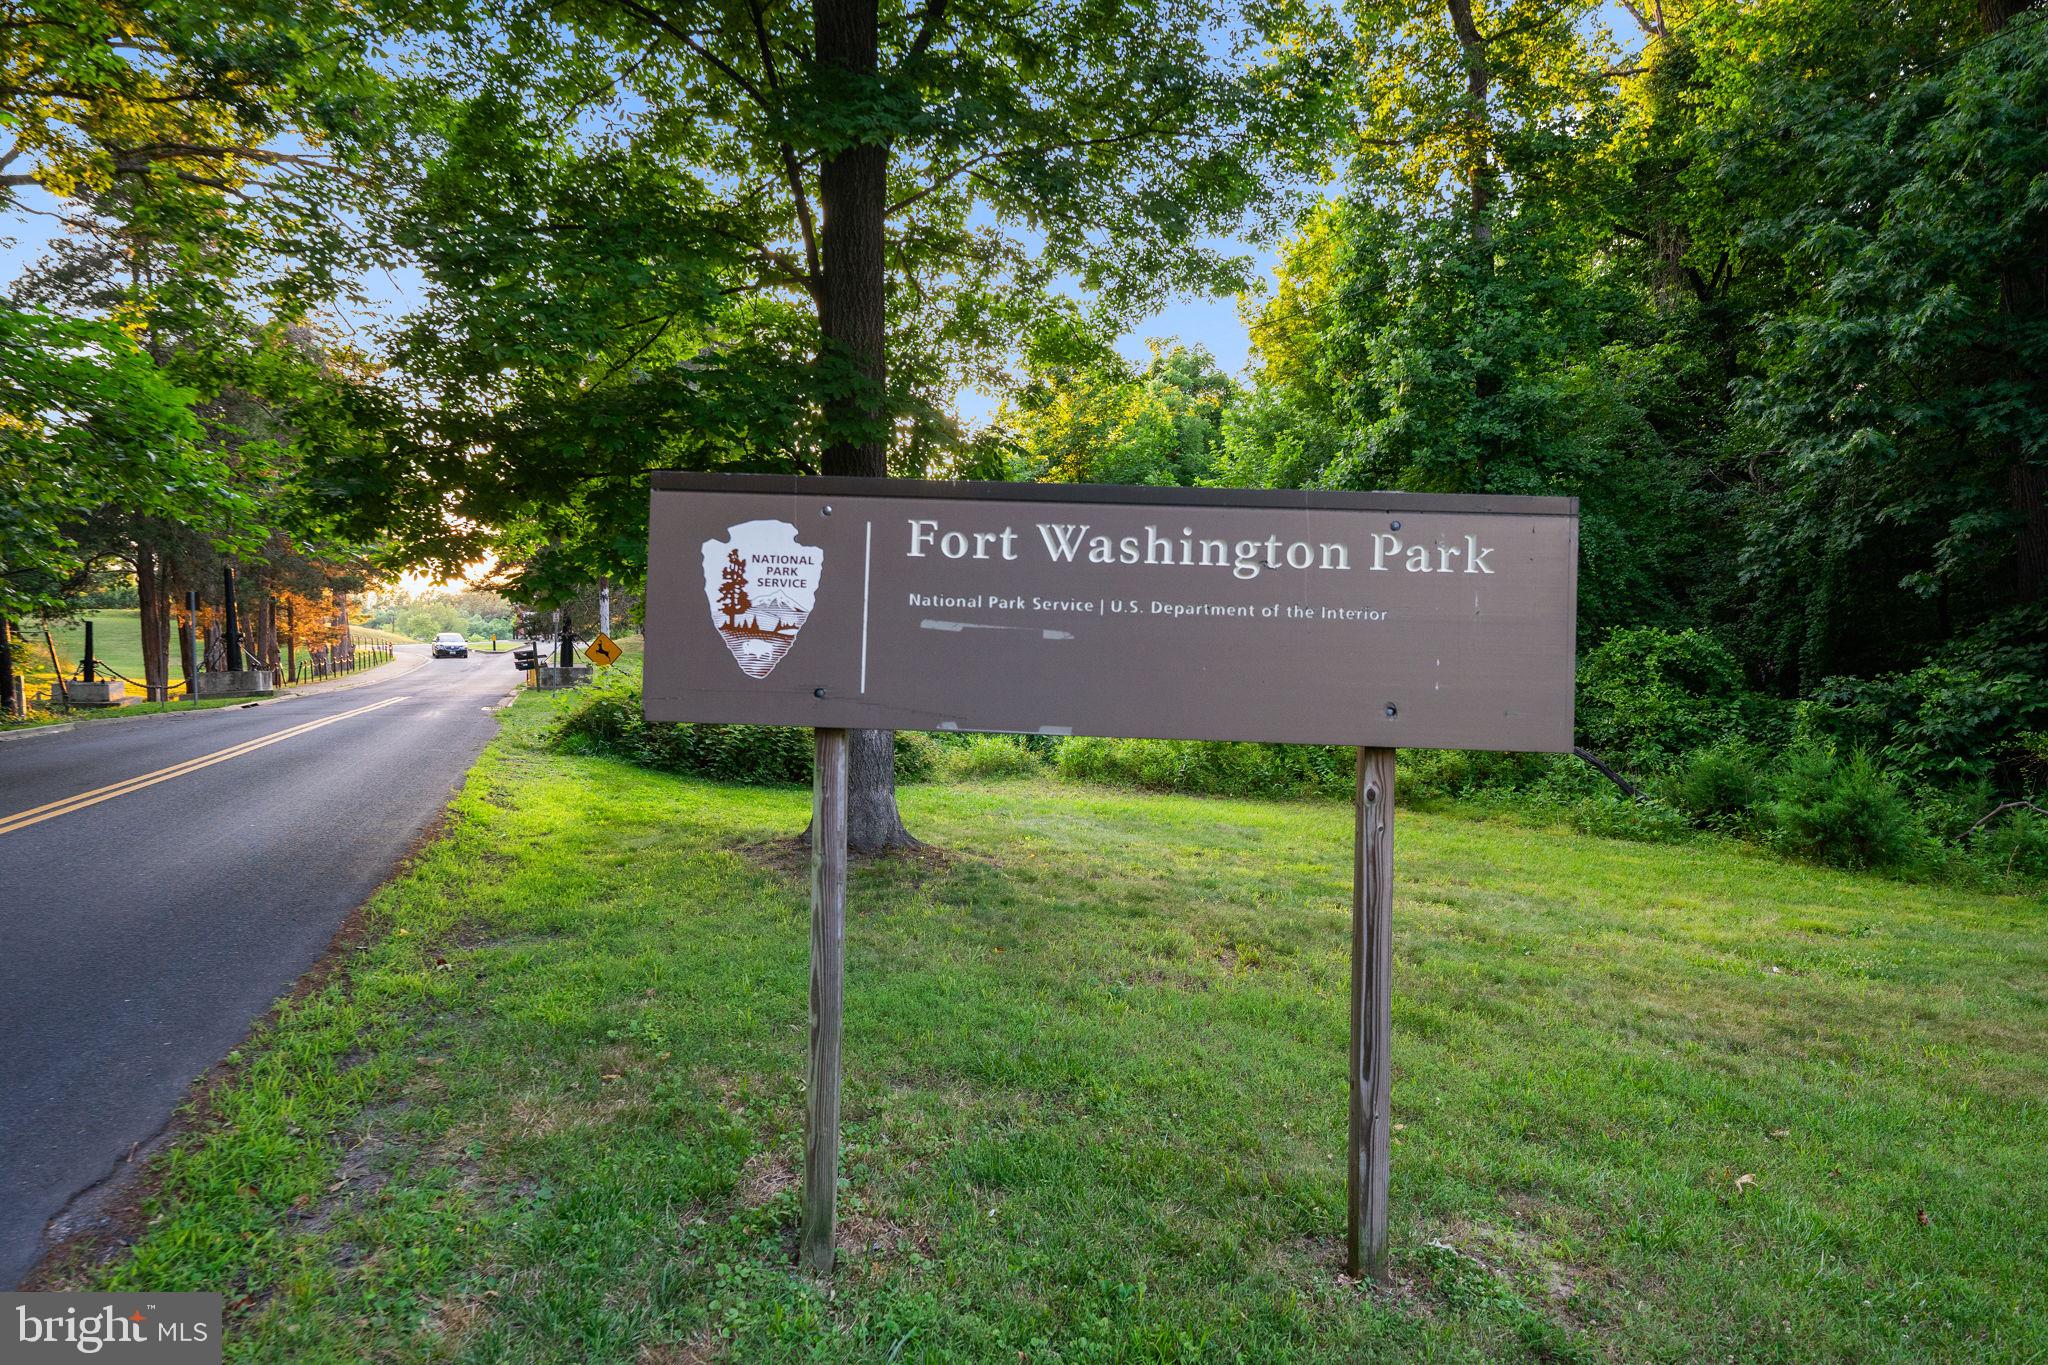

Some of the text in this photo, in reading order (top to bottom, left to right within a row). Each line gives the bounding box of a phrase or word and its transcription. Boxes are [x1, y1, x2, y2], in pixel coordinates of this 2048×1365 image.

[906, 519, 1495, 580] Fort Washington Park
[751, 554, 815, 566] NATIONAL
[766, 566, 798, 577] PARK
[757, 577, 807, 589] SERVICE
[908, 593, 982, 609] National
[988, 596, 1025, 610] Park
[1032, 597, 1094, 613] Service
[1110, 600, 1144, 614] U.S.
[1151, 601, 1255, 619] Department
[1261, 604, 1280, 618] of
[1286, 605, 1315, 619] the
[1321, 606, 1388, 621] Interior
